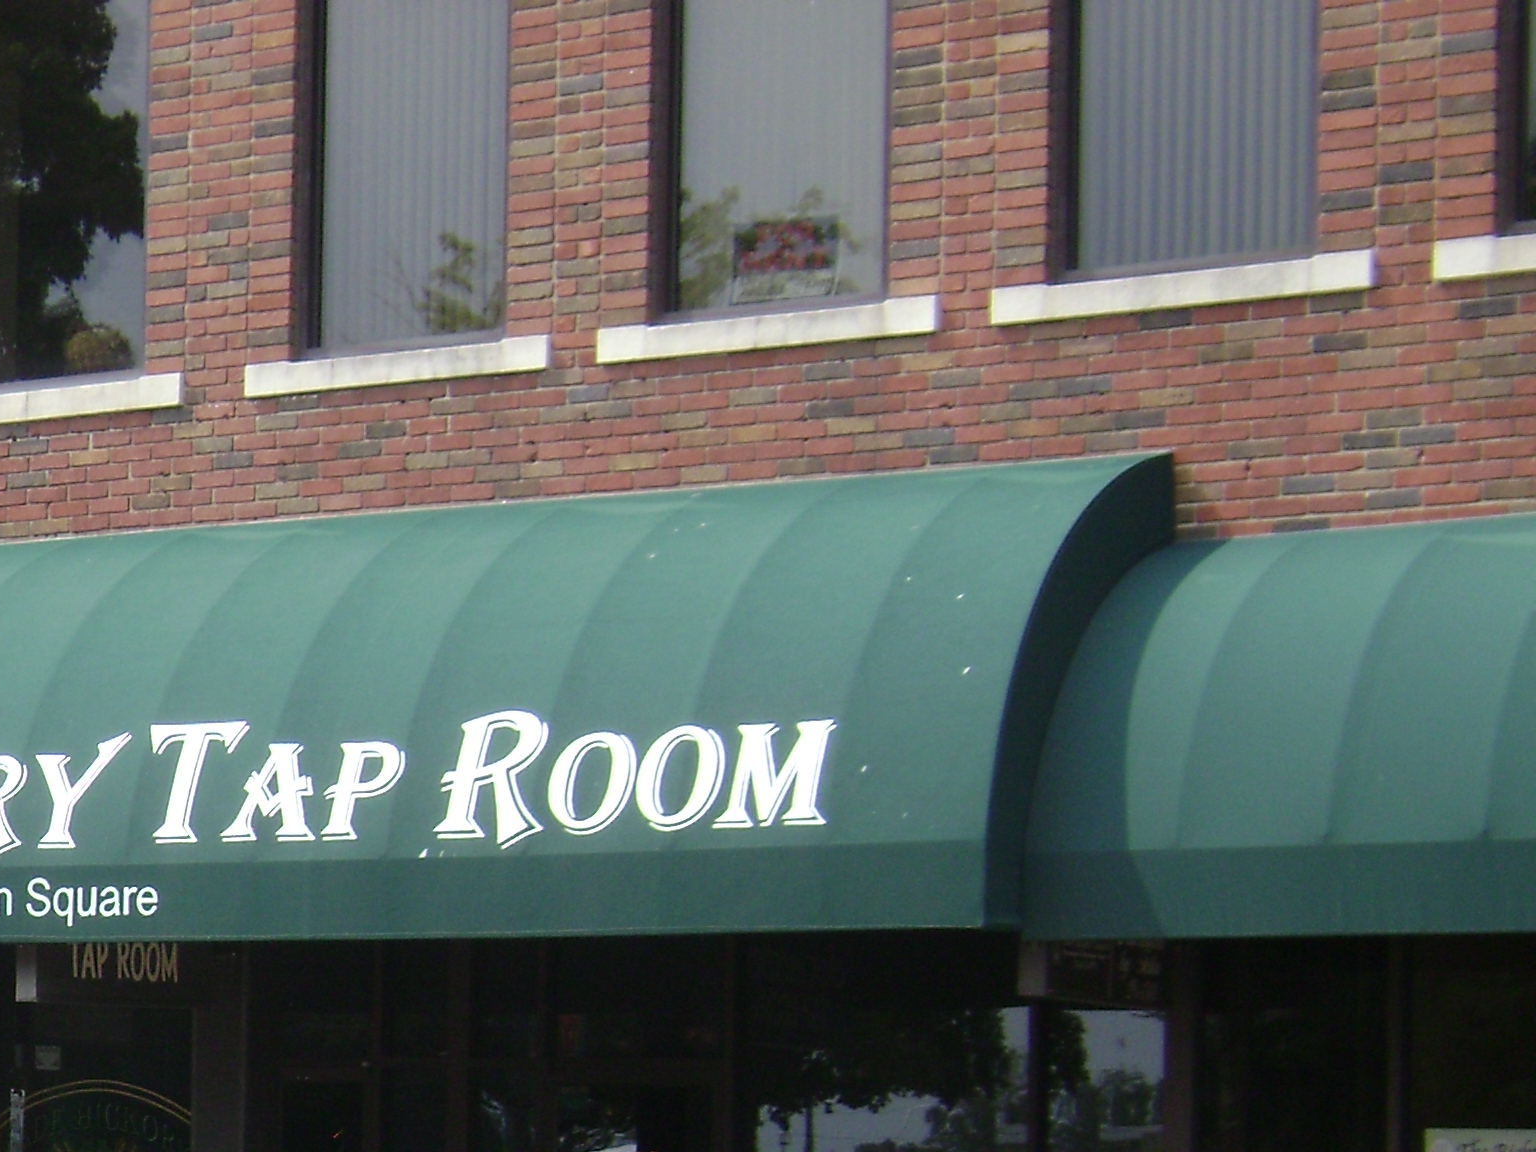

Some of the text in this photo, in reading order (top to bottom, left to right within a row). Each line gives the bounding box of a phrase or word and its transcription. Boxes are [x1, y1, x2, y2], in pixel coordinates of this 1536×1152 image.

[150, 720, 406, 844] TAP
[433, 709, 837, 850] ROOM
[25, 877, 159, 927] Square
[116, 942, 179, 983] ROOM
